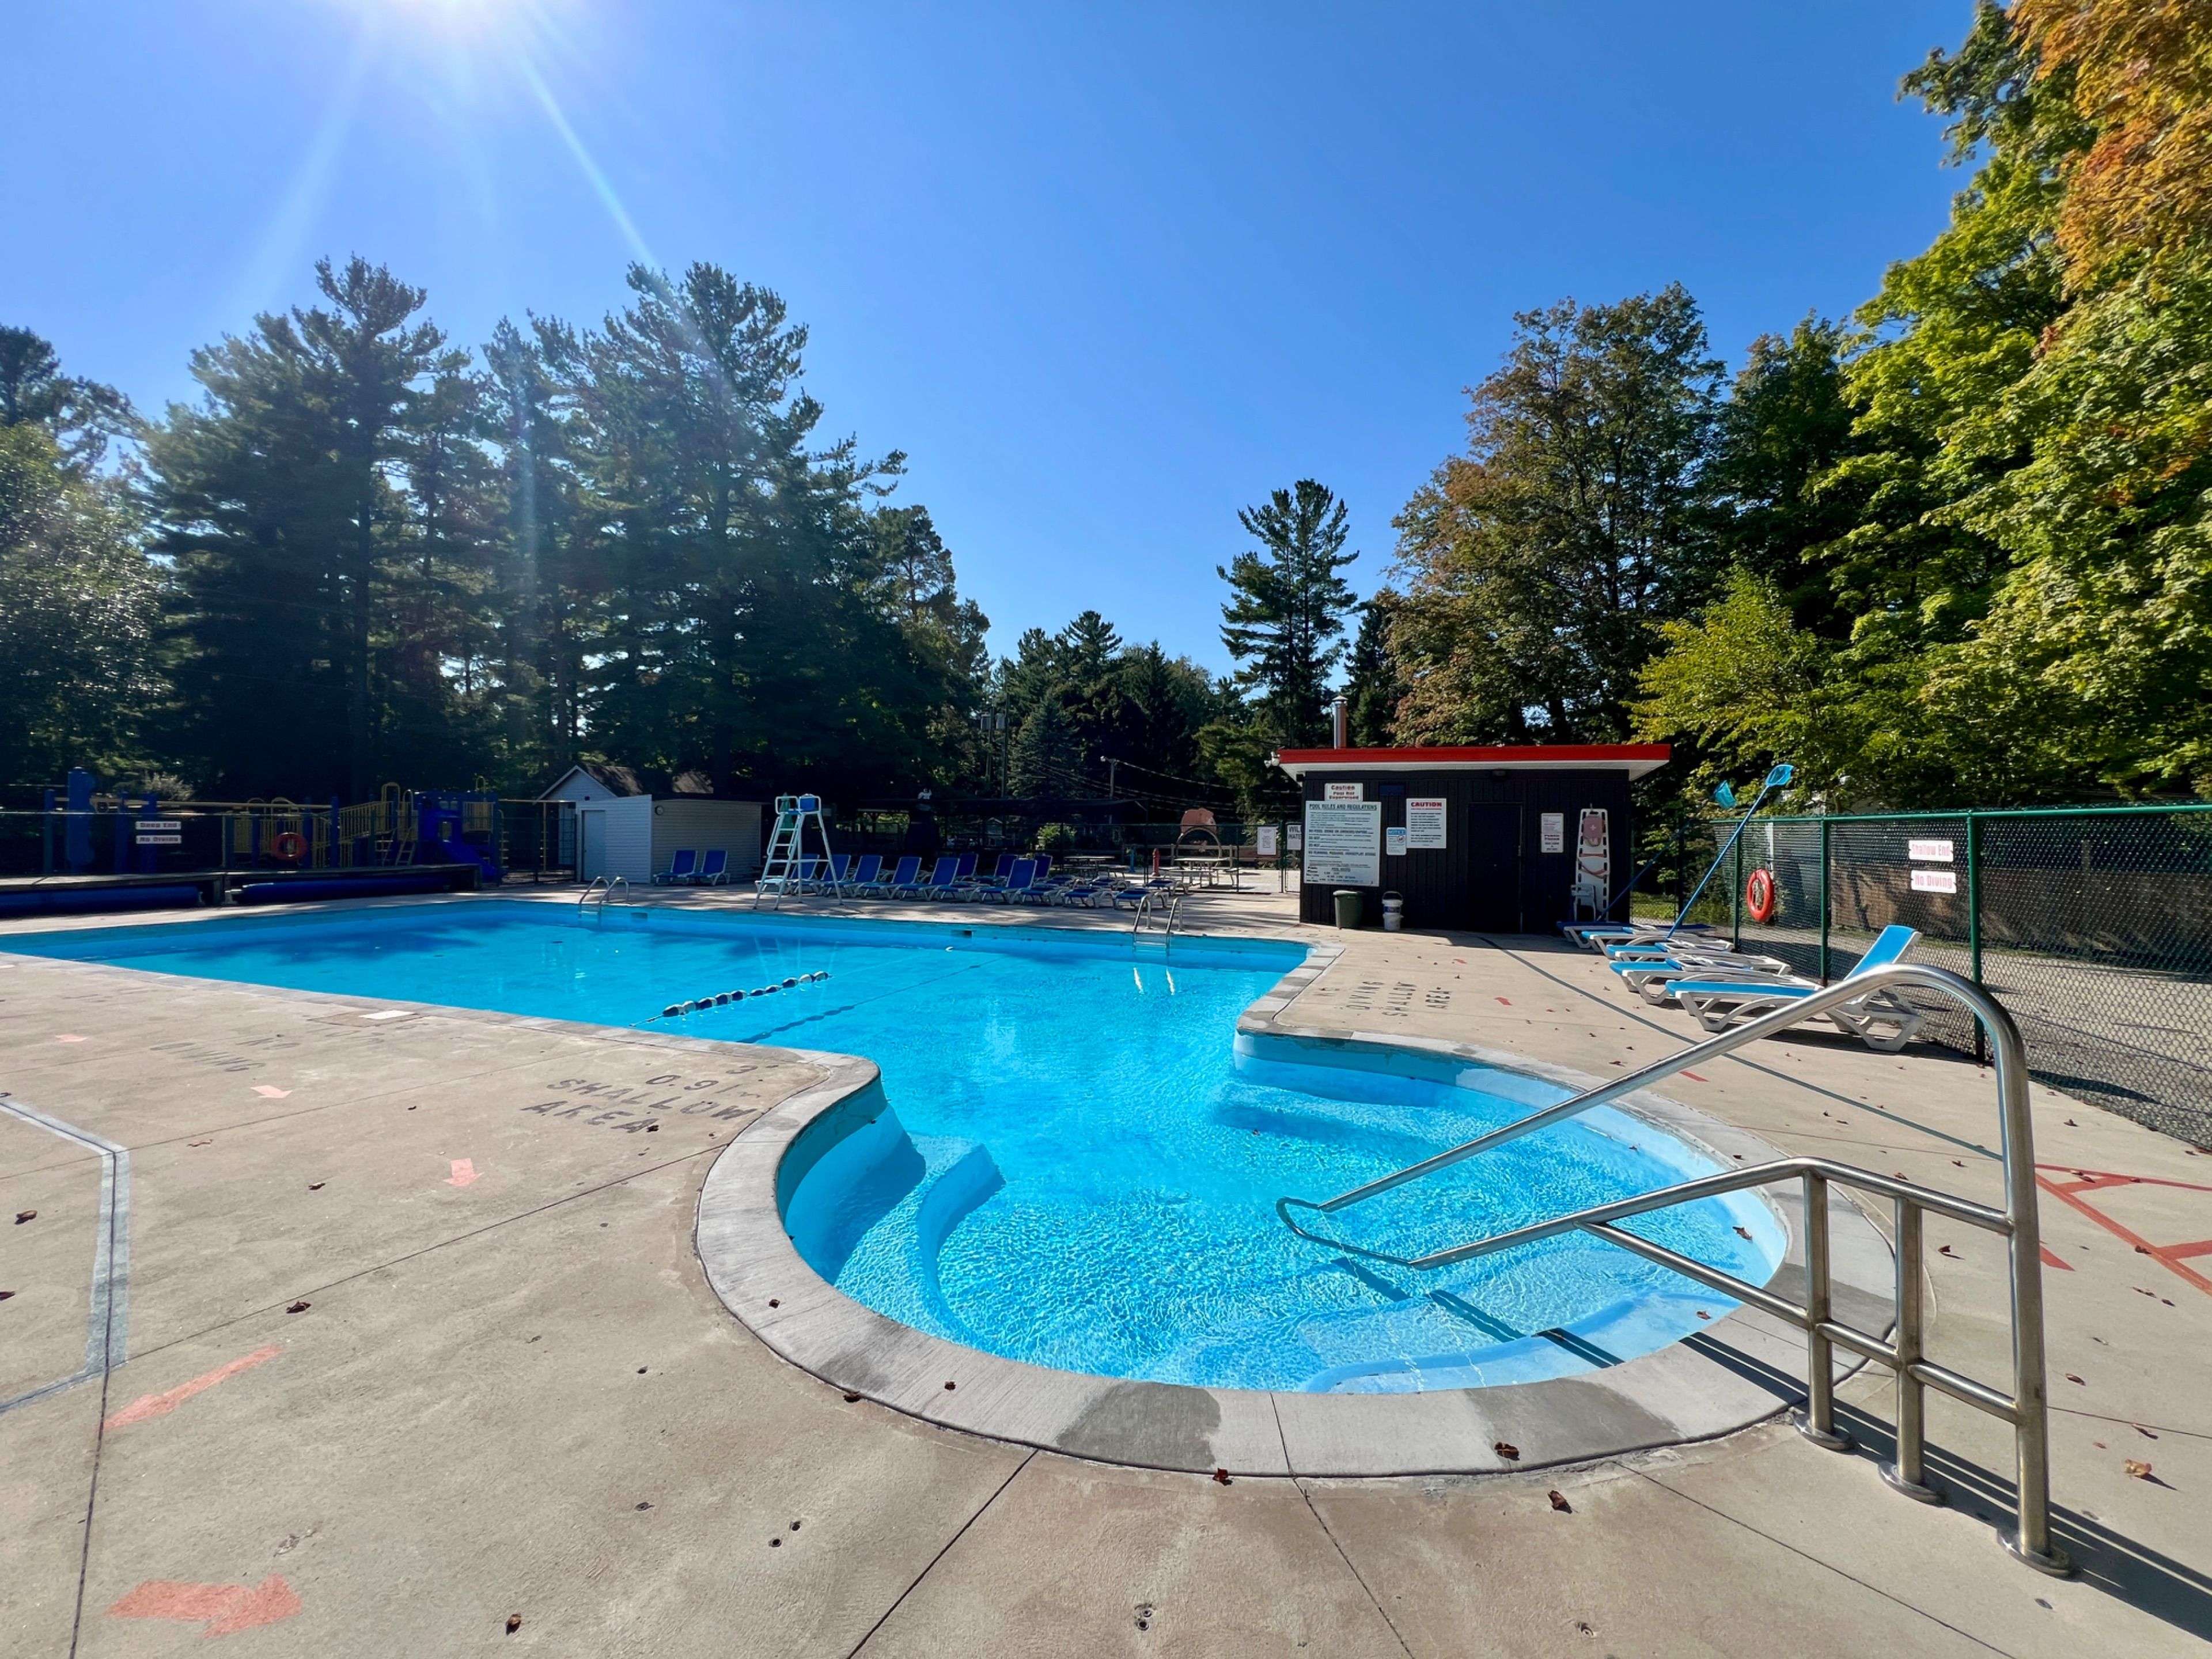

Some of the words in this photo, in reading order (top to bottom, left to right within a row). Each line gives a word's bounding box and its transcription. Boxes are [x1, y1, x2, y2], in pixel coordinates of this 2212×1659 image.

[1912, 844, 1936, 855] Shallow
[1938, 844, 1950, 856] End
[1915, 874, 1924, 885] No
[1927, 875, 1953, 889] Diving
[546, 1078, 758, 1120] SHALLOW
[520, 1100, 659, 1134] AREA
